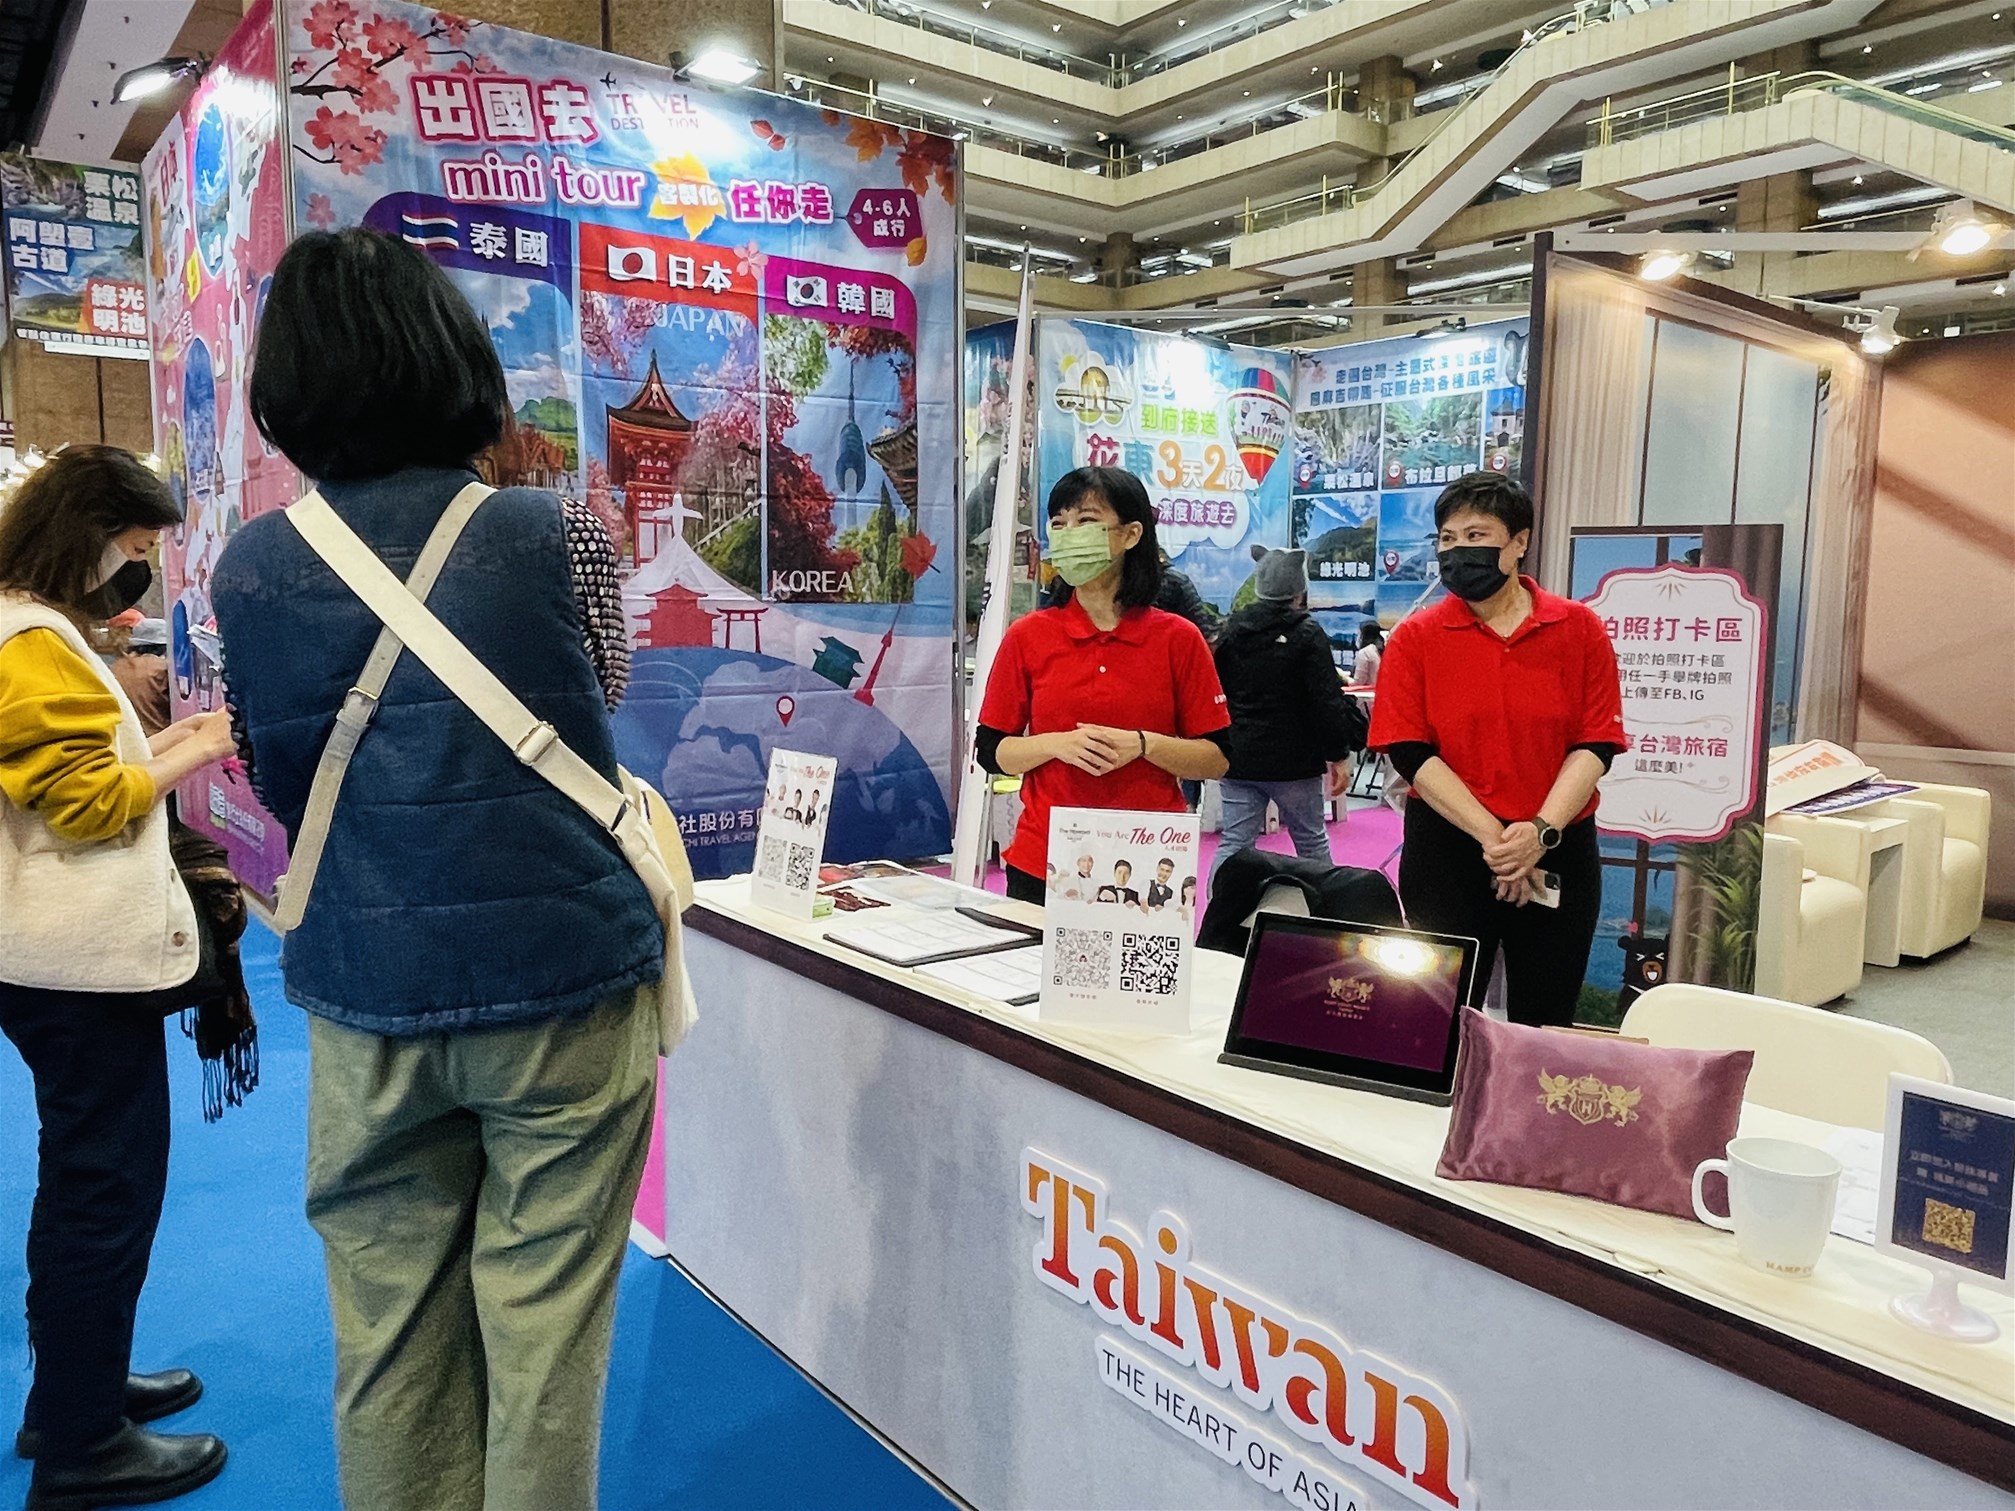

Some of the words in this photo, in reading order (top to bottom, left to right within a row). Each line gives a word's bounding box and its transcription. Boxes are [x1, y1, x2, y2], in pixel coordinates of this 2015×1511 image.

[413, 76, 597, 142] 出國去
[606, 93, 696, 115] TRVEL
[446, 152, 545, 202] mini
[553, 158, 645, 205] tour
[656, 182, 719, 206] 客製化
[729, 179, 834, 224] 任你走
[469, 221, 549, 268] 泰國
[872, 219, 906, 237] 成行
[11, 243, 68, 272] 古道
[668, 254, 733, 294] 日本
[836, 281, 895, 320] 韓國
[93, 309, 147, 336] 明池
[653, 303, 746, 338] JAPAN
[1141, 403, 1218, 437] 到府接送
[1086, 434, 1243, 492] 花東3天2夜
[771, 571, 853, 593] KOREA
[1616, 653, 1726, 668] 迎於拍照打卡區
[700, 834, 731, 846] TRAVEL
[1129, 827, 1155, 845] The
[1160, 826, 1192, 844] One
[1028, 1162, 1460, 1509] Taiwan
[1102, 1348, 1146, 1398] THE
[1155, 1382, 1238, 1452] HEART
[1248, 1441, 1283, 1478] OF
